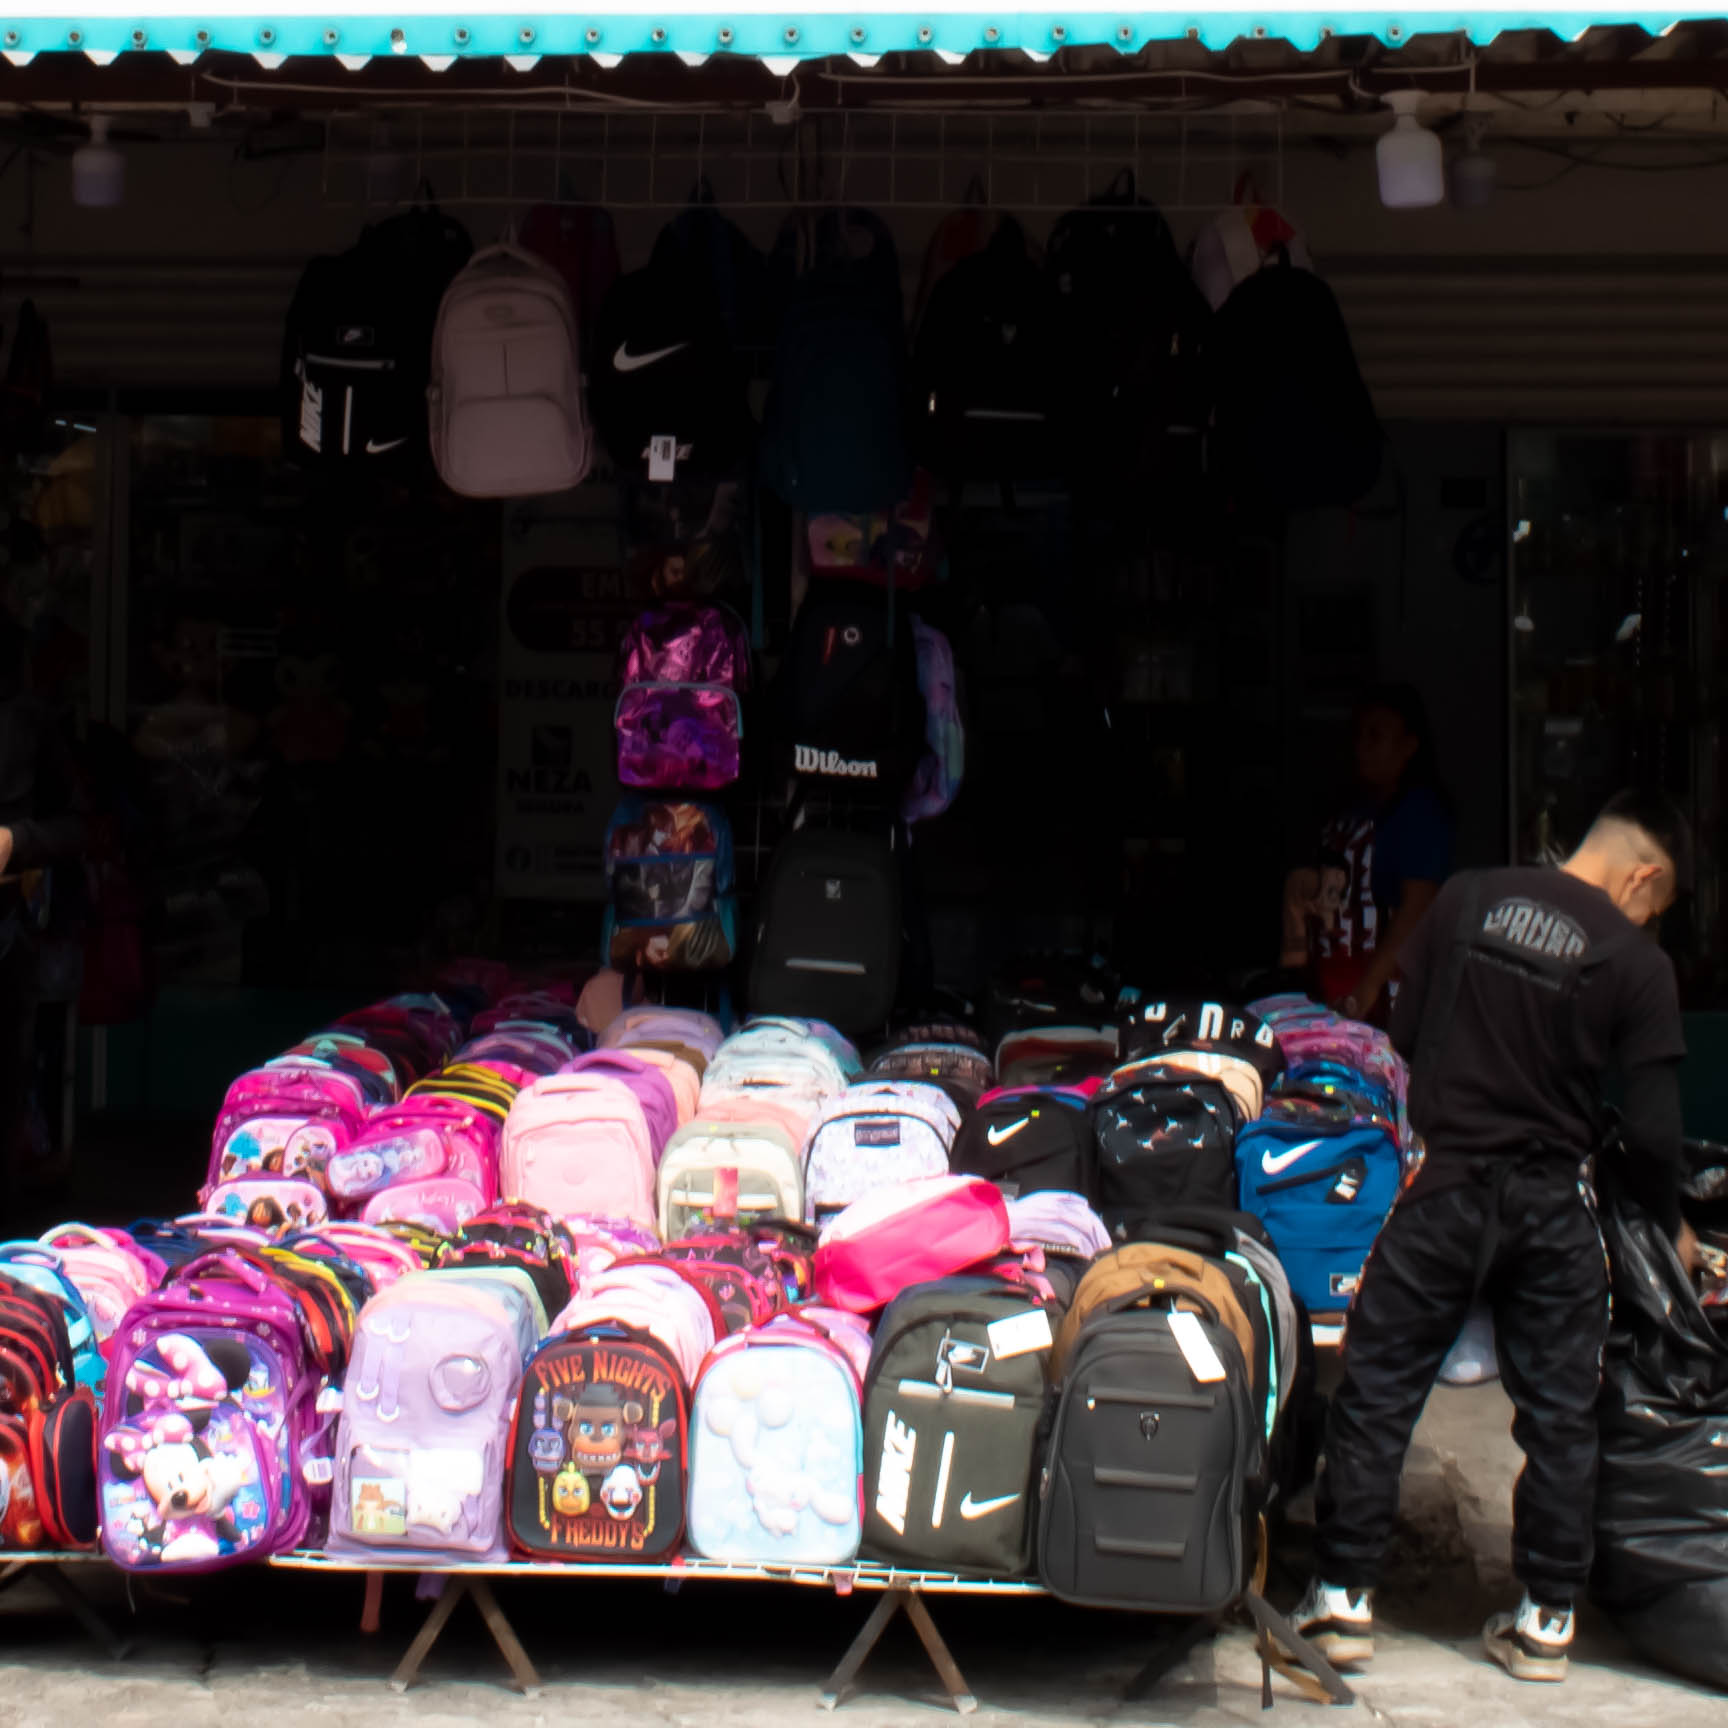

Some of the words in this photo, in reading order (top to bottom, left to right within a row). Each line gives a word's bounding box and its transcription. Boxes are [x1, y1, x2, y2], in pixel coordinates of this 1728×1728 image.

[506, 768, 592, 793] NEZA
[794, 743, 879, 780] Wilson
[534, 1353, 585, 1392] FIVE
[593, 1349, 673, 1402] NIGHTS
[876, 1408, 917, 1536] NIKE
